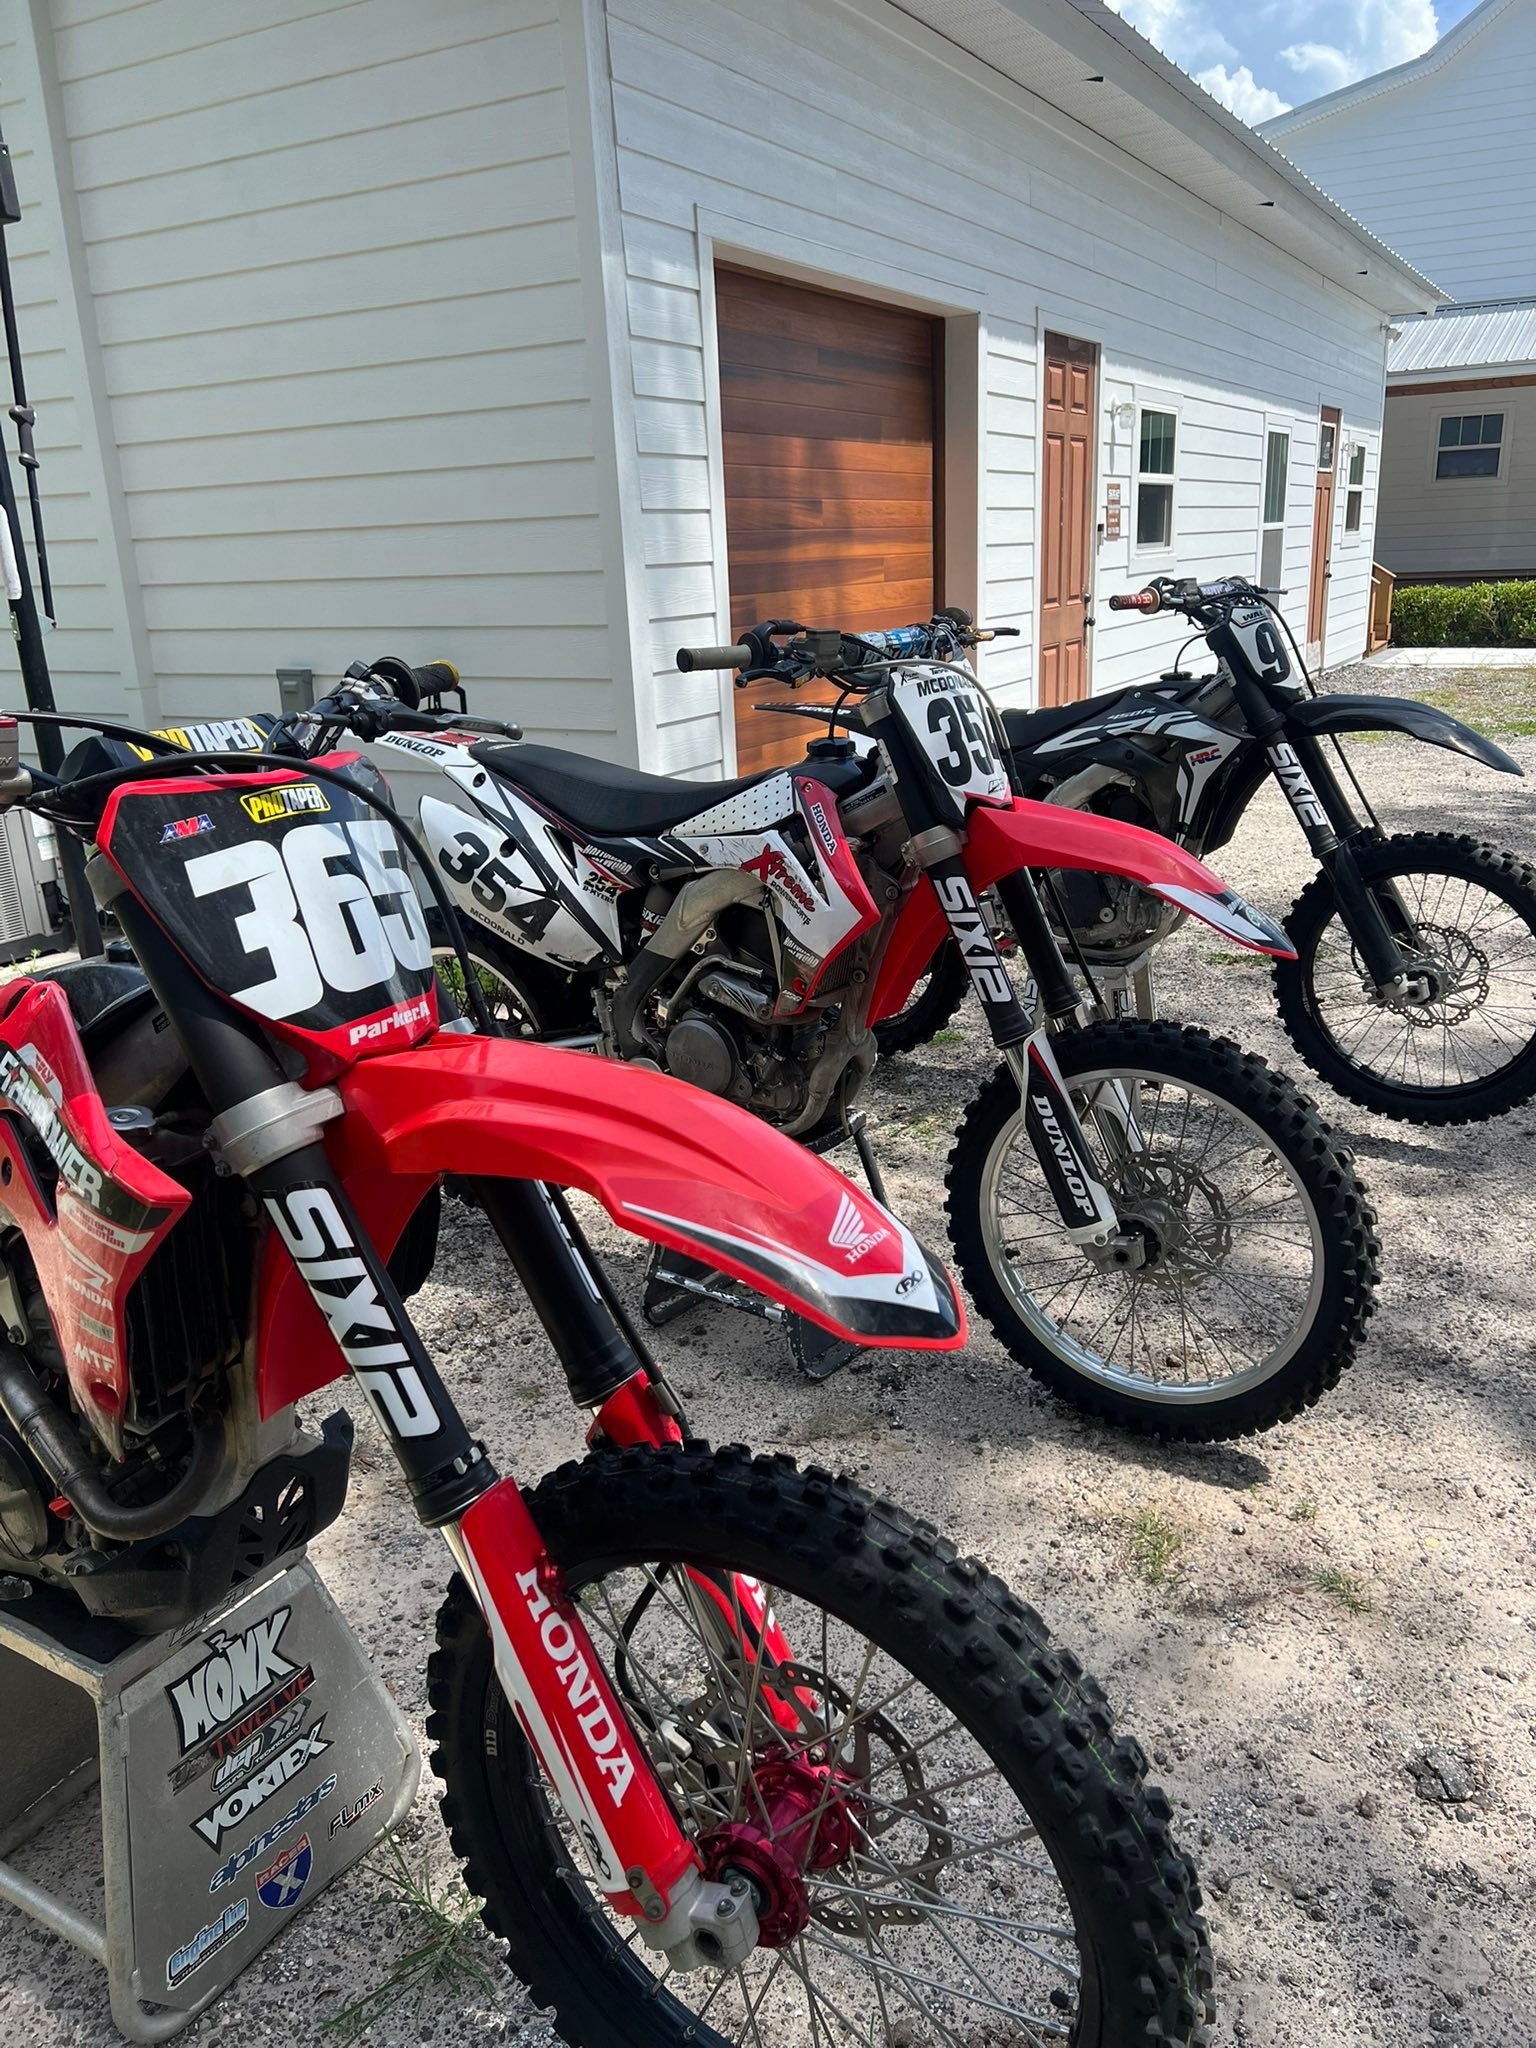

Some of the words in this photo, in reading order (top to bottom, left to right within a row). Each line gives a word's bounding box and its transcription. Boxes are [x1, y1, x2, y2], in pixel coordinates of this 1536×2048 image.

[1255, 622, 1291, 686] 9
[384, 735, 446, 758] DUNLOP
[1190, 748, 1222, 767] HRC
[249, 786, 323, 820] PROTAPER
[160, 814, 216, 843] AMA
[812, 804, 837, 856] HONDA
[438, 831, 561, 945] 354
[584, 870, 619, 898] 254
[184, 819, 435, 1020] 365
[469, 907, 526, 946] MCDONALD
[1032, 1094, 1098, 1219] DUNLOP
[845, 1227, 891, 1264] HONDA
[64, 1274, 114, 1312] HONDA
[515, 1566, 636, 1808] HONDA
[195, 1722, 329, 1845] VORTEX
[209, 1774, 338, 1893] alpinestars
[259, 1837, 307, 1885] RACER
